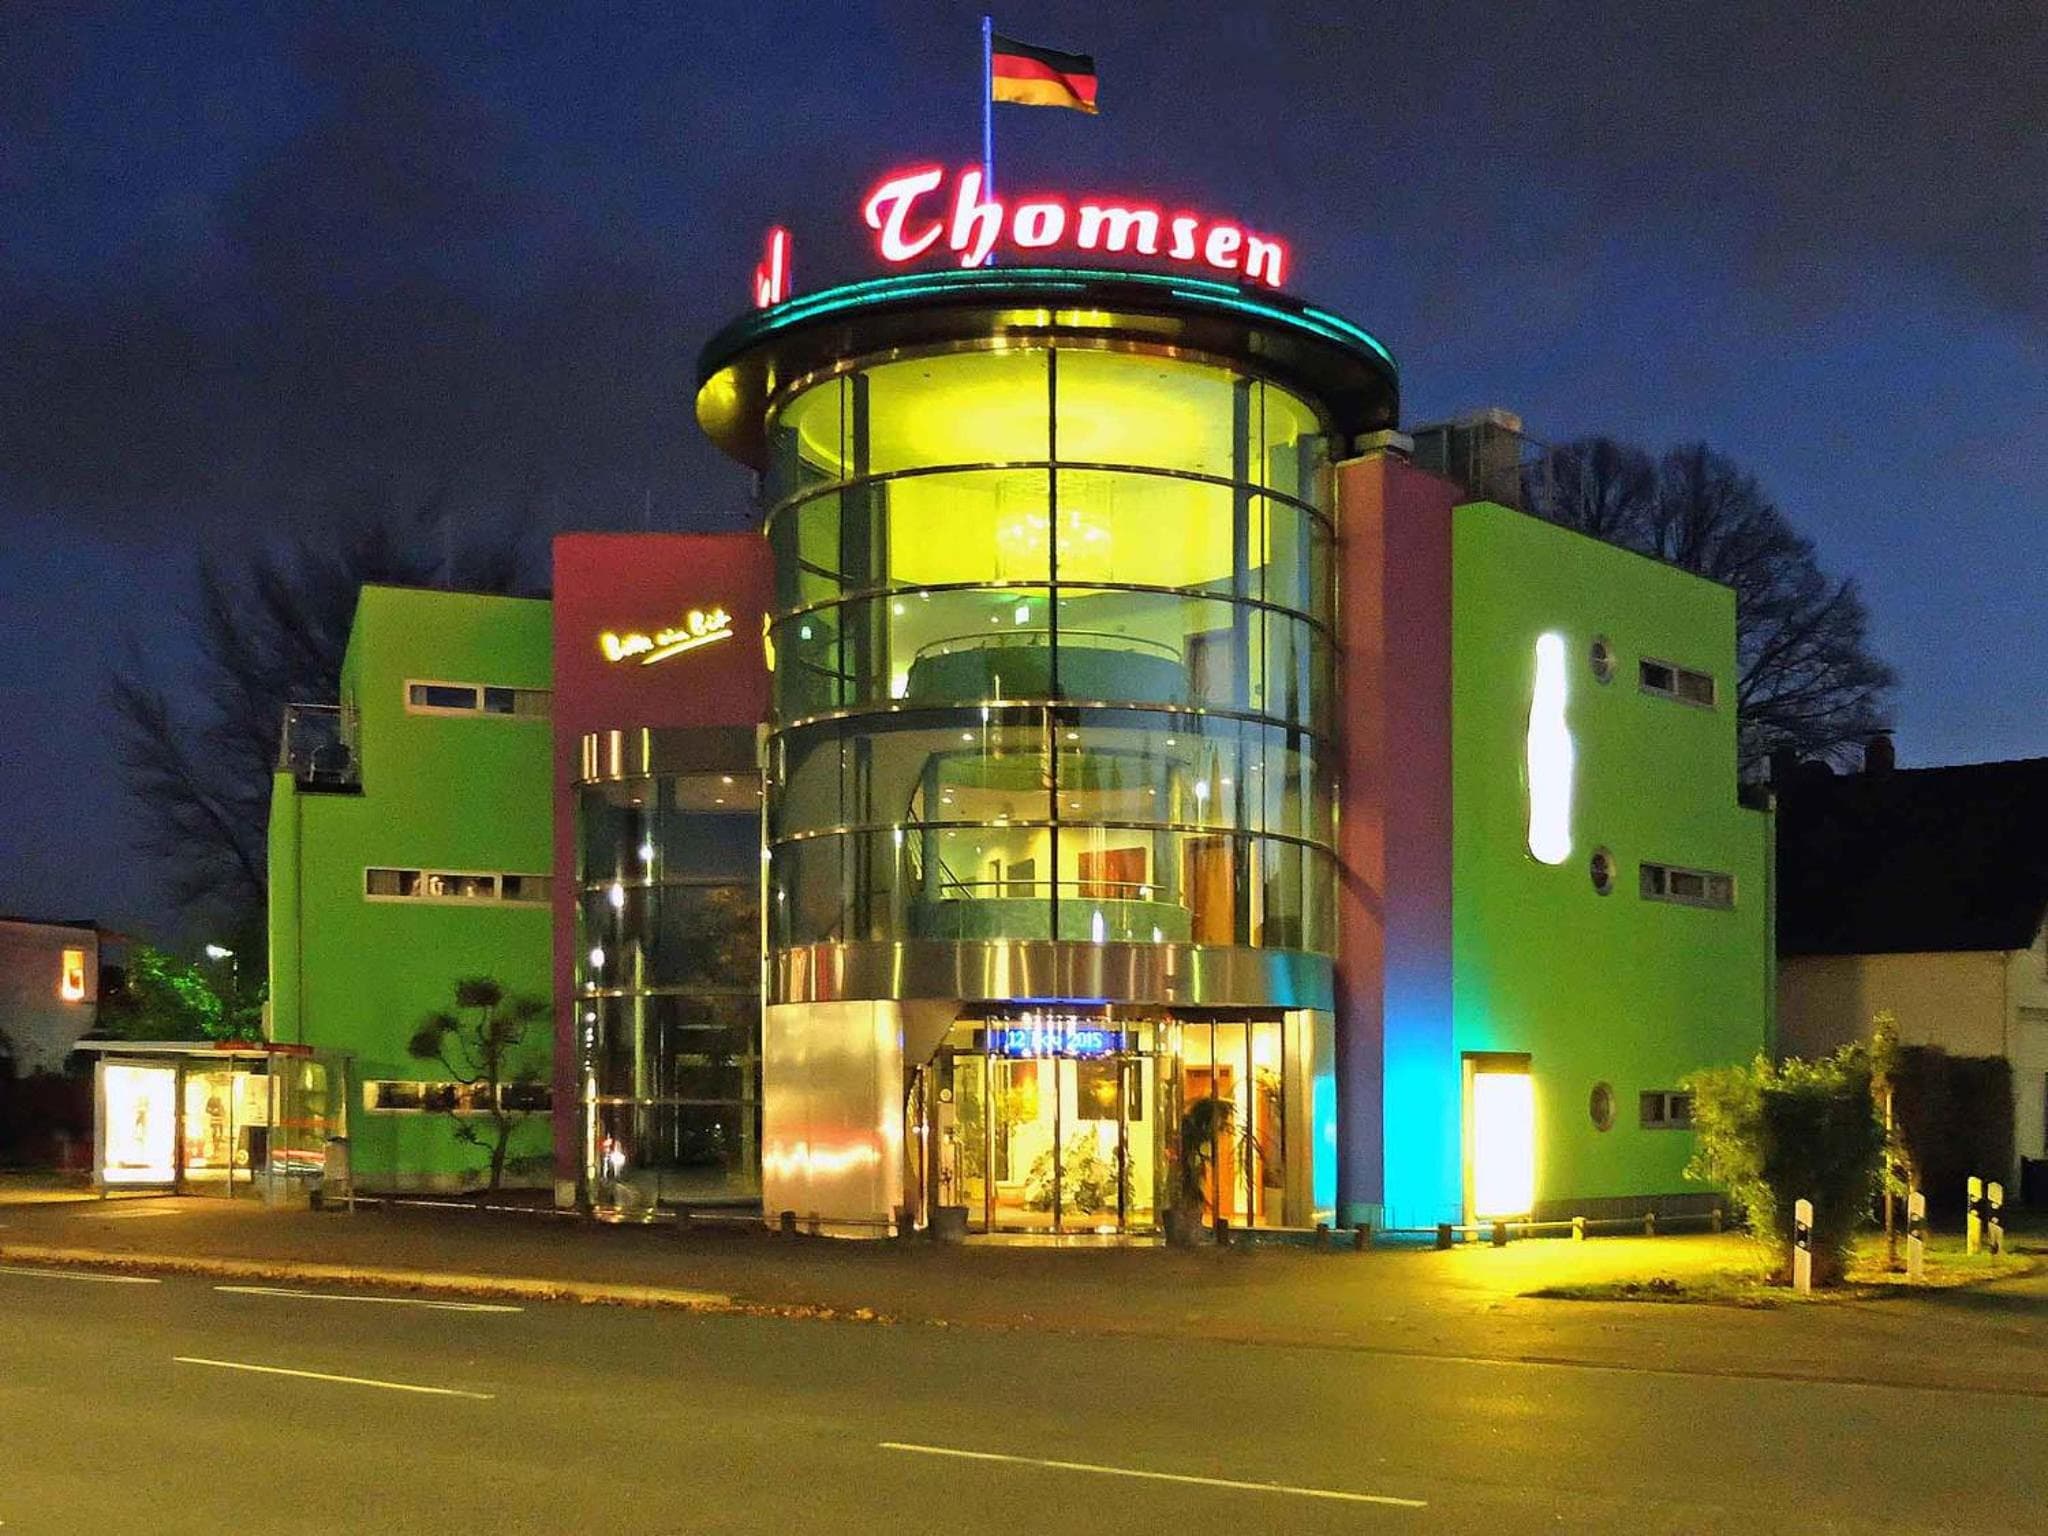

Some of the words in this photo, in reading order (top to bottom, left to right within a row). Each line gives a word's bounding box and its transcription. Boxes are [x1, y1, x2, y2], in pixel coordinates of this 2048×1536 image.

[864, 167, 1285, 288] Thomsen
[1008, 1030, 1025, 1047] 12
[1067, 1031, 1103, 1048] 2015
